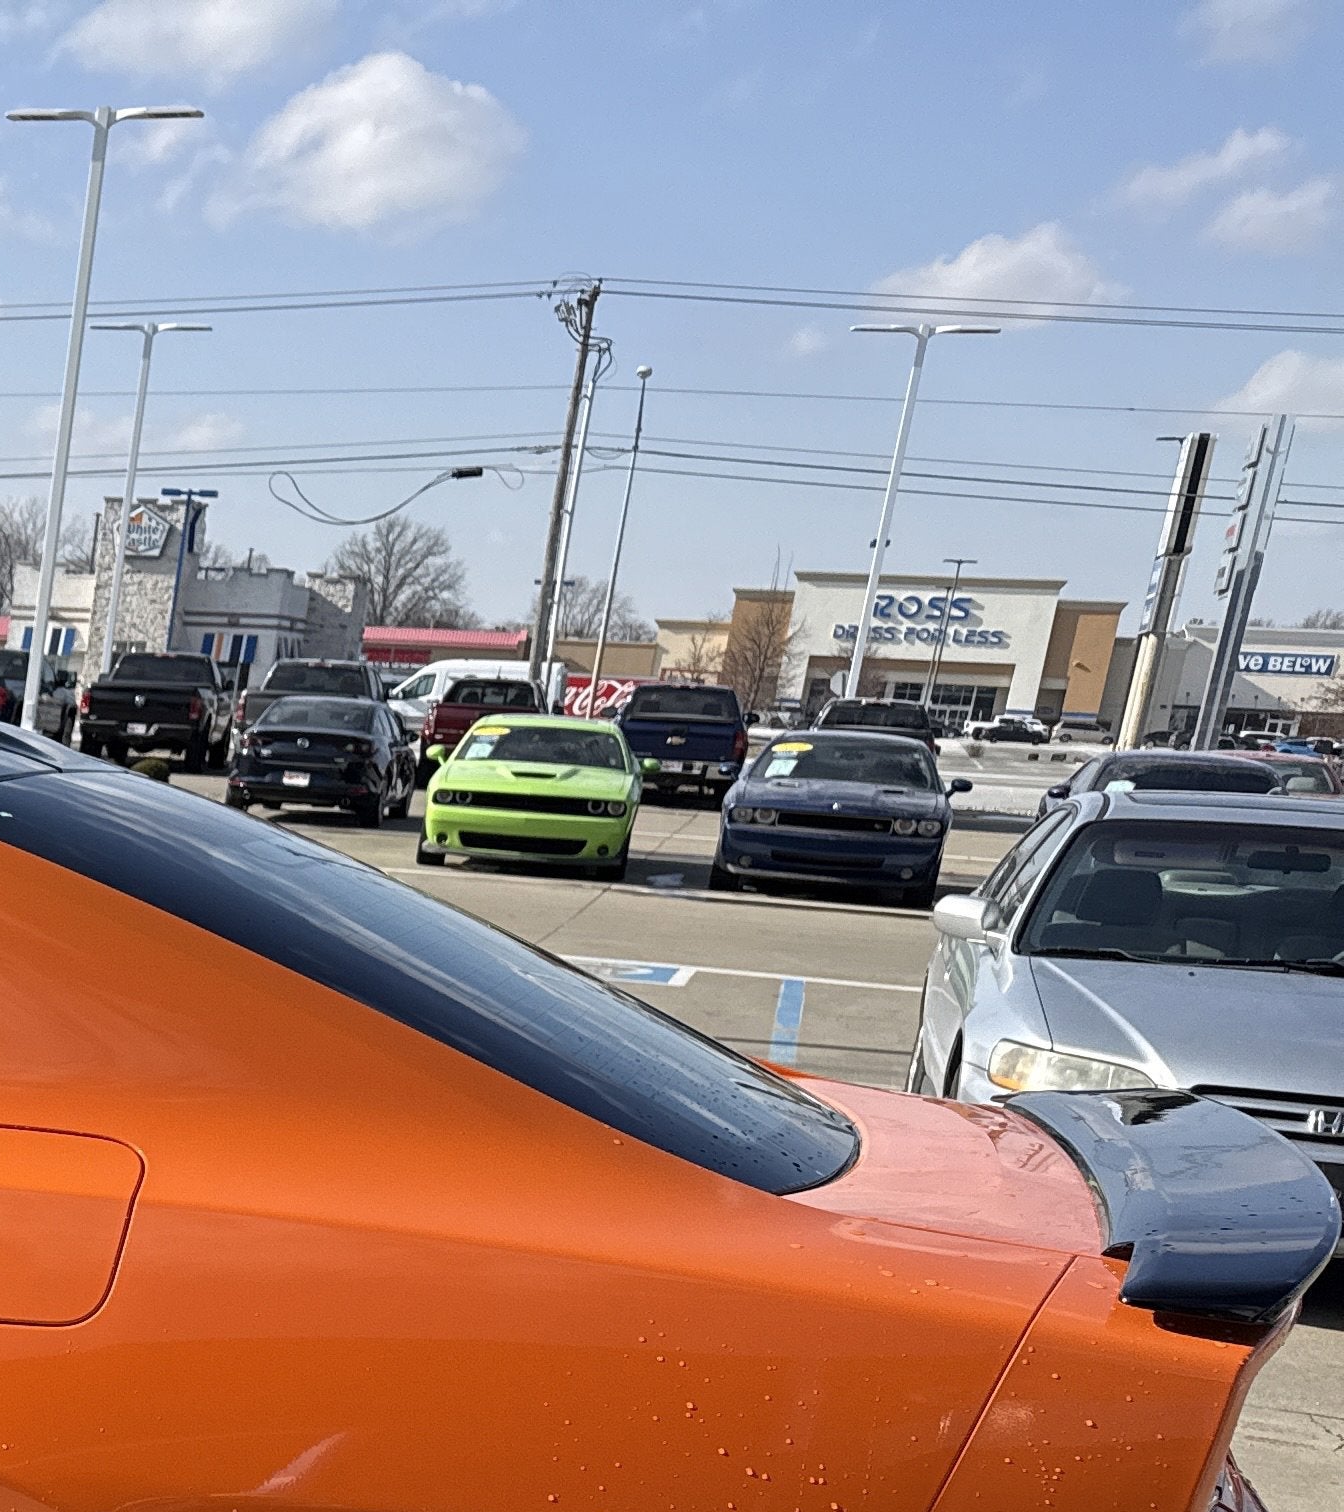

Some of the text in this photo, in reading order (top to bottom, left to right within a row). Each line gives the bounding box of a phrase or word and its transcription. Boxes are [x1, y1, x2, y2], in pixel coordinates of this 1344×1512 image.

[126, 535, 161, 547] astle
[872, 594, 974, 620] ROSS
[832, 624, 1005, 645] DRSS FOR LESS
[1267, 655, 1332, 673] BELOW
